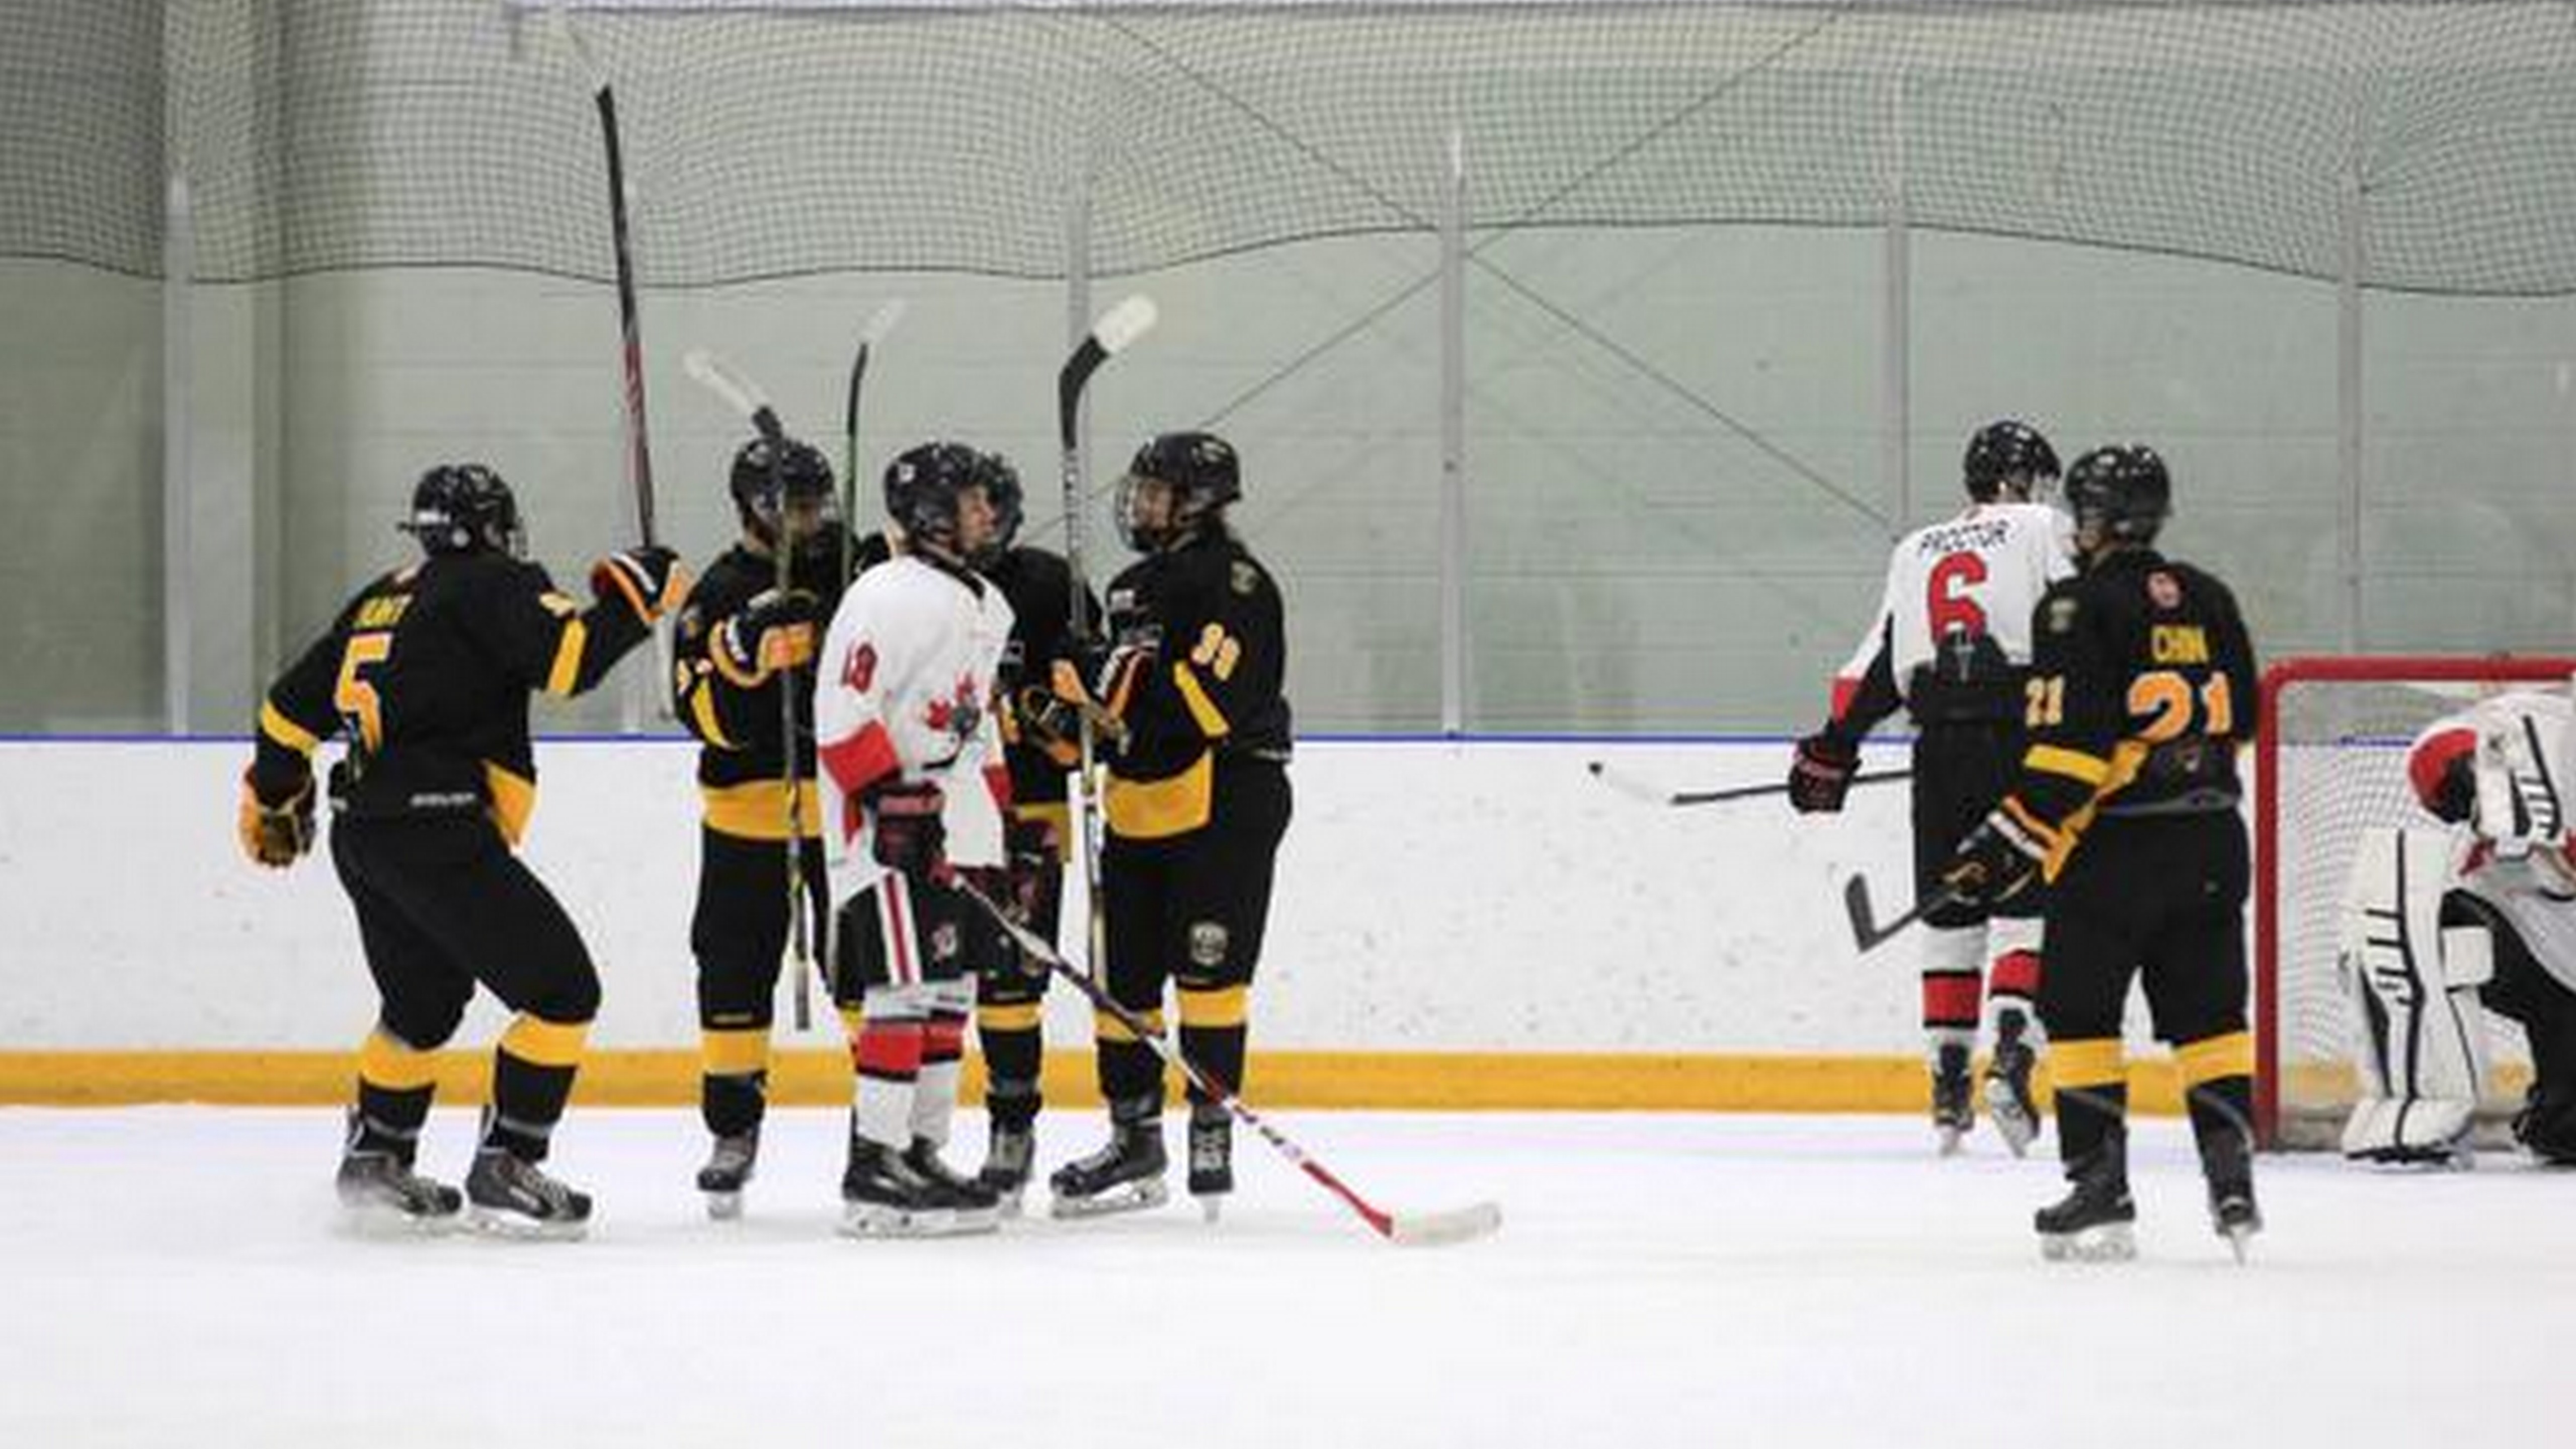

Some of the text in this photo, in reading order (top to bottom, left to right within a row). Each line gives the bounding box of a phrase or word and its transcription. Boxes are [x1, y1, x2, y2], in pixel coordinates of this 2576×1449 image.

[1928, 550, 1987, 644] 6
[334, 632, 393, 756] 5
[2128, 670, 2232, 745] 21
